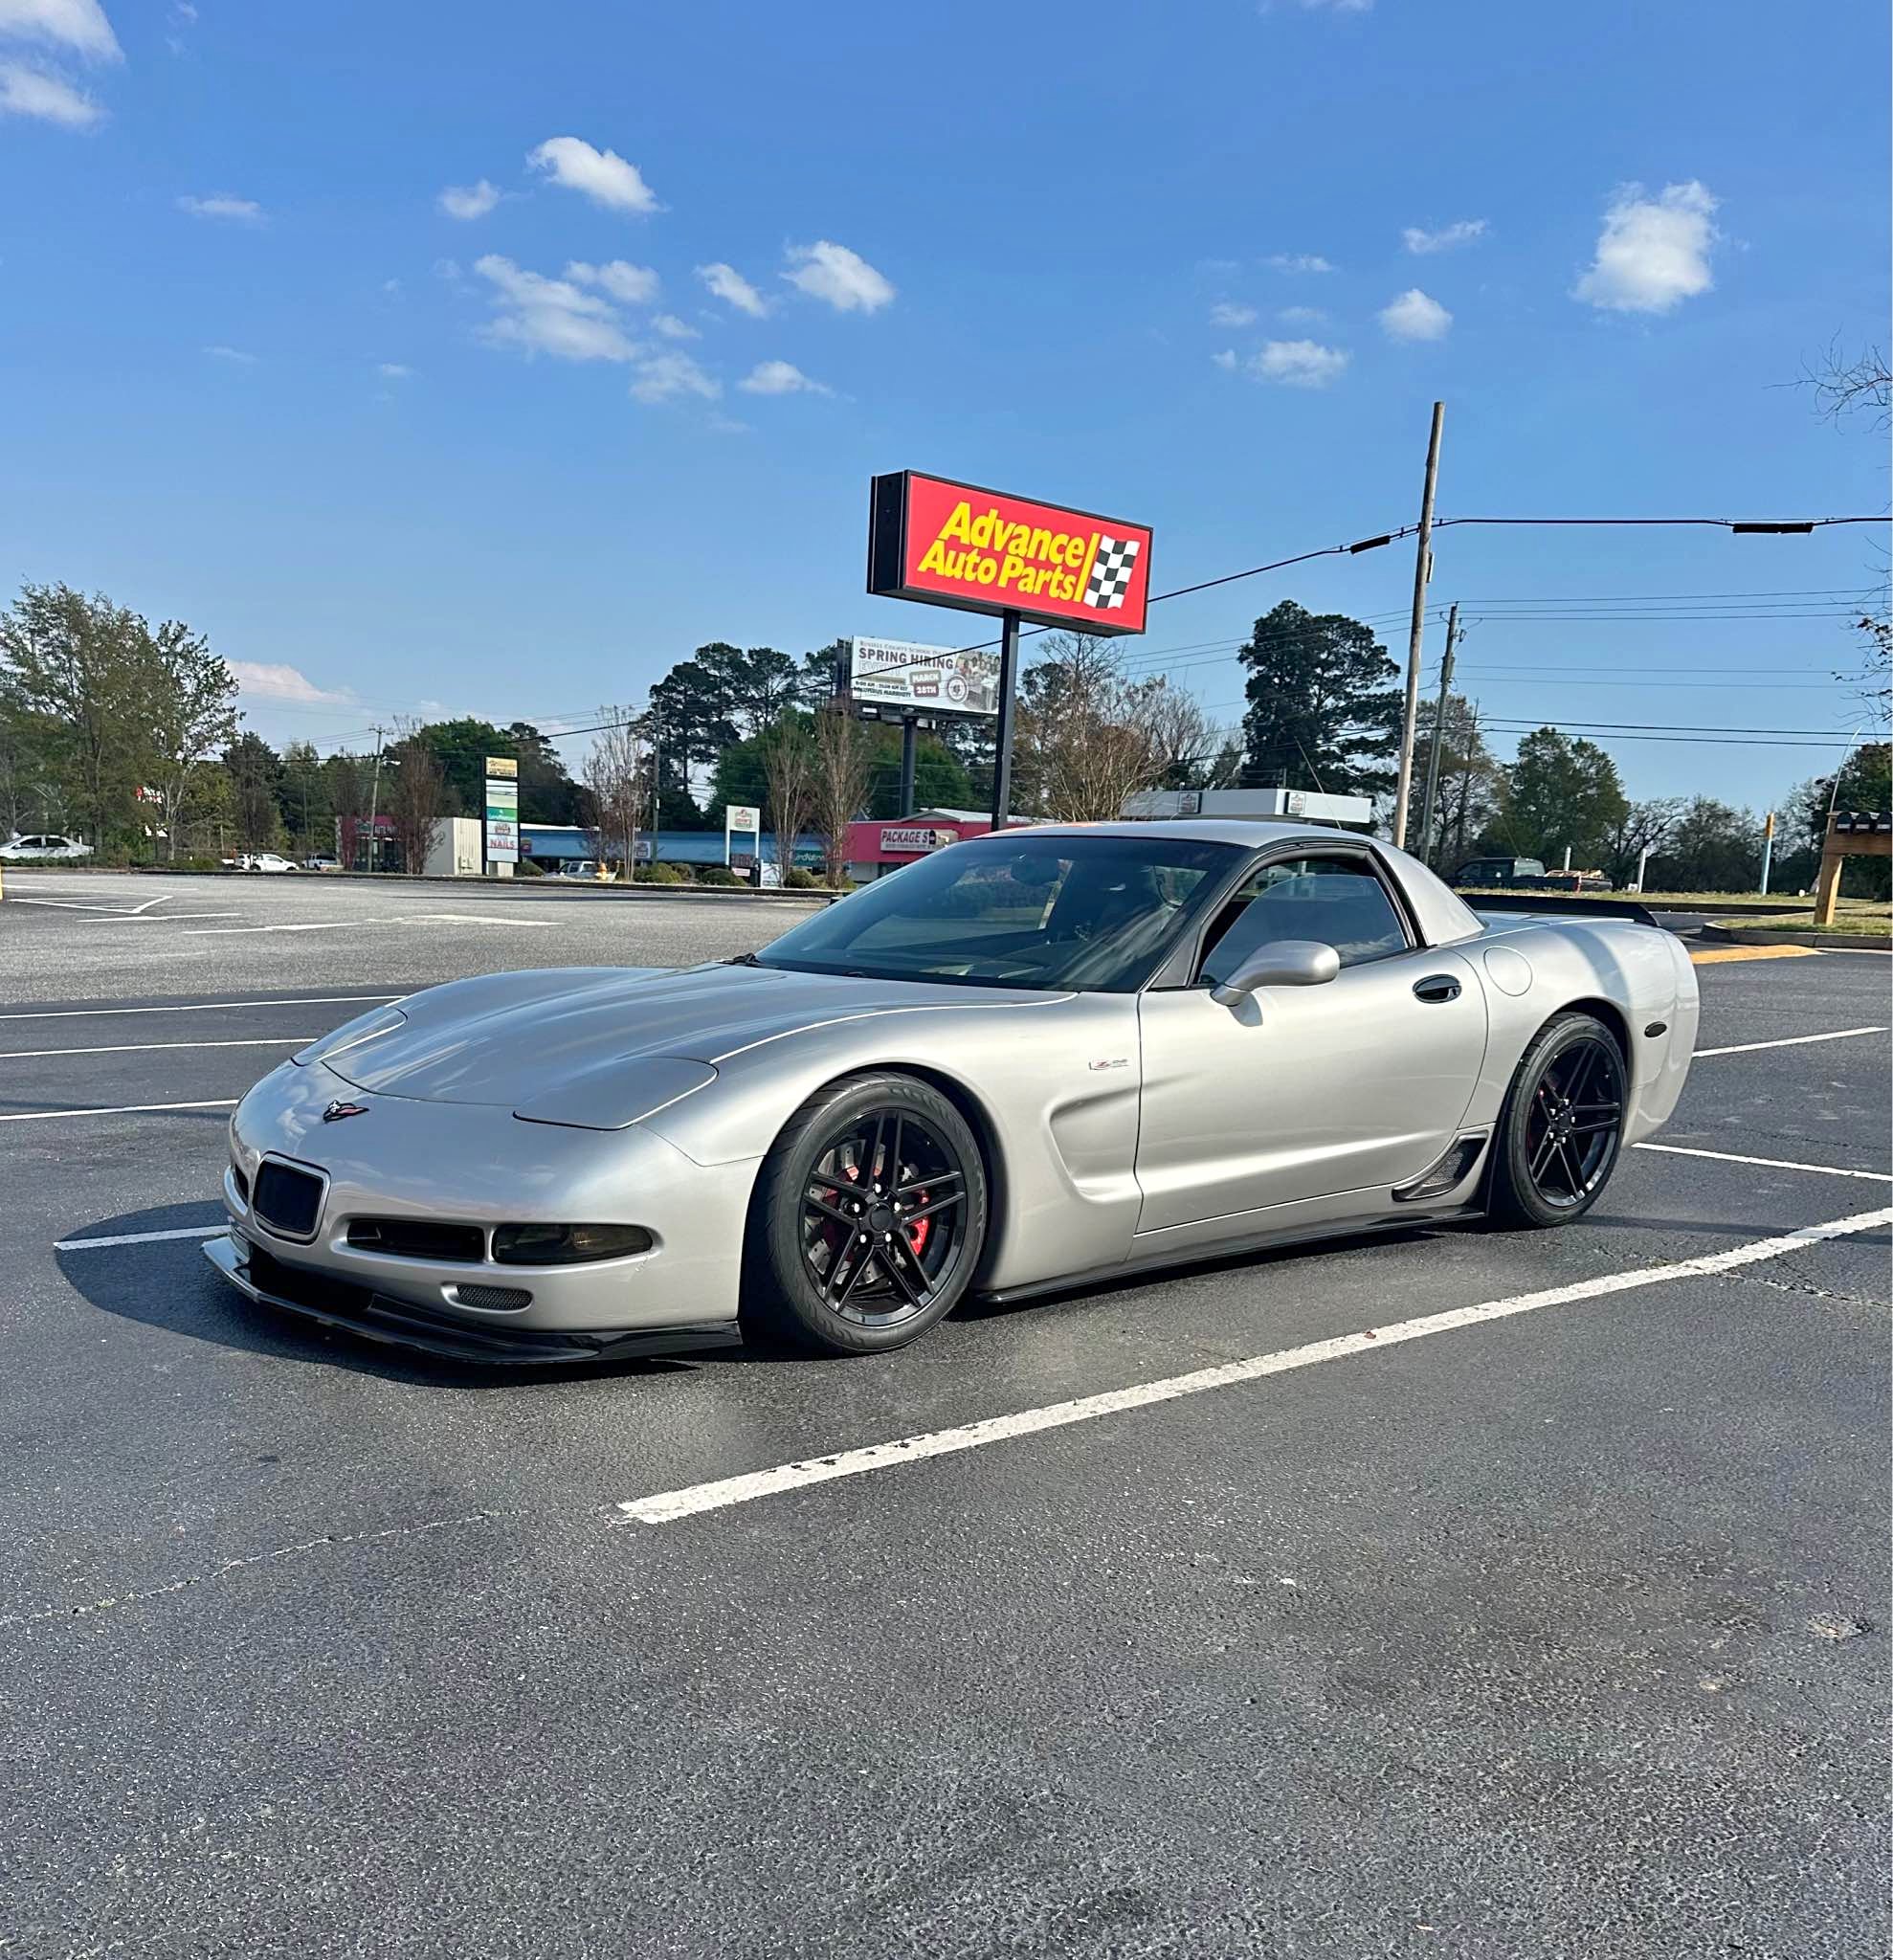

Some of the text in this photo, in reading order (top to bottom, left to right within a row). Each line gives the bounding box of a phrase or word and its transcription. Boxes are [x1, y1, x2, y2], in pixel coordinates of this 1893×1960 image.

[937, 501, 1084, 568] Advance
[917, 540, 1077, 602] Auto Parts
[858, 647, 953, 670] SPRING HIRING
[490, 839, 514, 850] NAILS
[881, 831, 921, 843] PACKAGE
